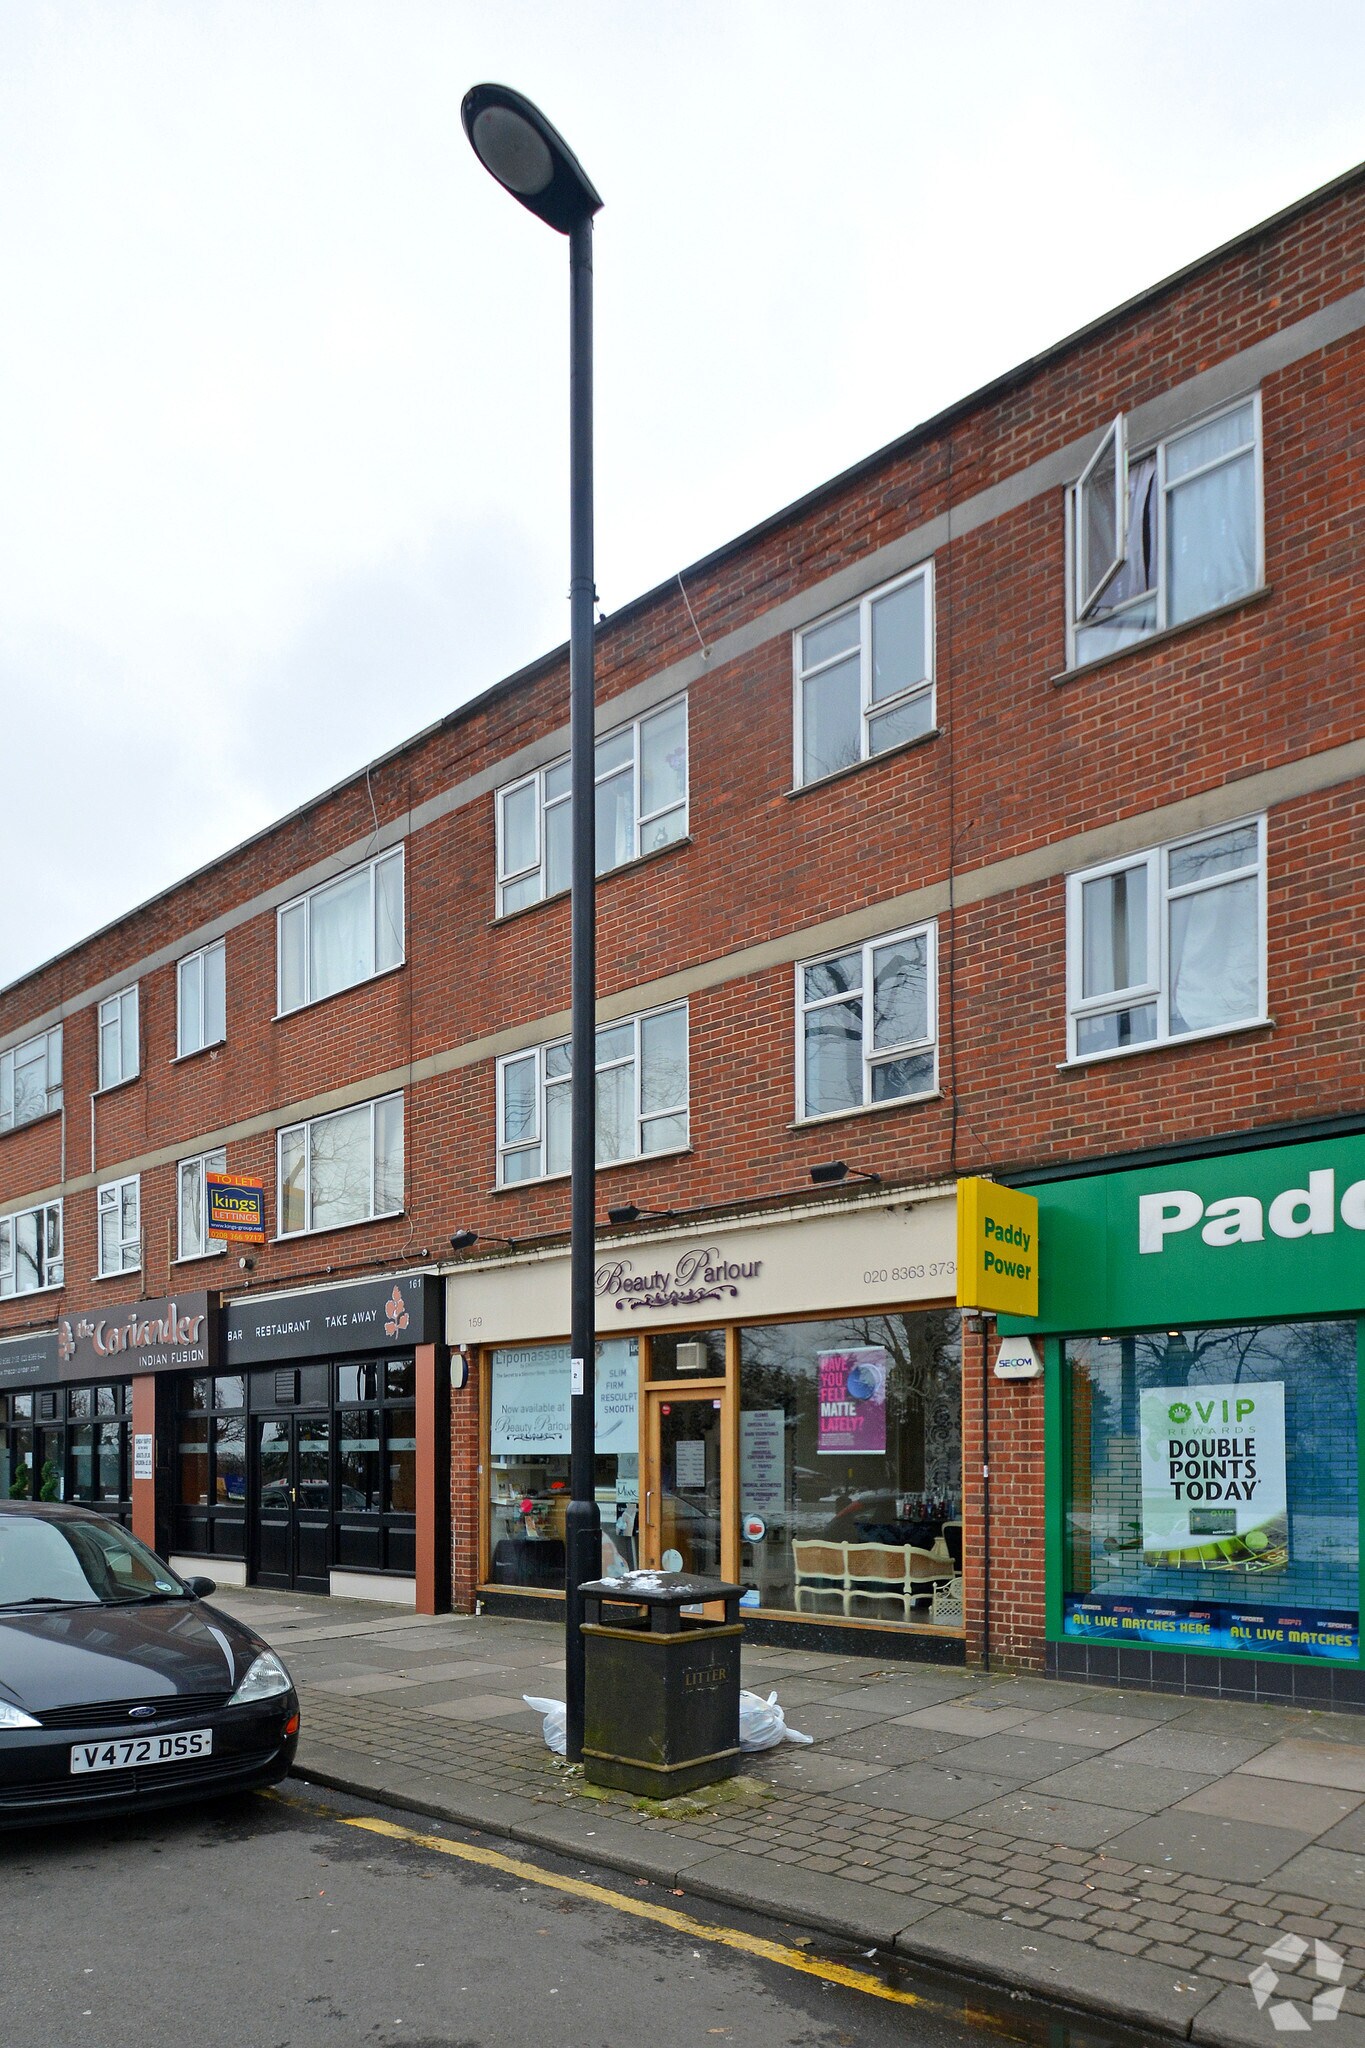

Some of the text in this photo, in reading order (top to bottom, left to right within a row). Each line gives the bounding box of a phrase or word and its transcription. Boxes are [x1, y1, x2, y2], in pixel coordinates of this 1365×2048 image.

[214, 1174, 254, 1187] TO LET
[215, 1193, 257, 1212] kings
[214, 1211, 258, 1222] LETTINGS
[210, 1223, 262, 1232] www.kings-group.net
[211, 1231, 228, 1239] 0208
[984, 1216, 1031, 1252] Paddy
[594, 1247, 763, 1297] Beauty Parlour
[863, 1261, 958, 1284] 020 8363 373
[984, 1250, 1031, 1280] Power
[408, 1278, 421, 1289] 161
[227, 1309, 378, 1341] BAR RESTAURANT TAKE AWAY
[468, 1316, 483, 1328] 159
[92, 1302, 205, 1358] Coriander
[139, 1349, 205, 1367] INDIAN FUSION
[821, 1356, 848, 1371] HAVE
[998, 1357, 1032, 1368] SECOM
[608, 1369, 627, 1378] SLIM
[821, 1372, 843, 1387] YOU
[605, 1381, 624, 1390] FIRM
[600, 1392, 638, 1402] RESCULPT
[821, 1387, 847, 1402] FELT
[501, 1403, 565, 1414] Now available at
[604, 1405, 635, 1414] SMOOTH
[821, 1402, 857, 1416] MATTE
[1195, 1398, 1255, 1424] VIP
[494, 1414, 571, 1434] Beauty Parlou
[821, 1416, 864, 1432] LATELY?
[1168, 1426, 1256, 1436] REWARDS
[1169, 1438, 1256, 1459] DOUBLE
[1170, 1460, 1257, 1479] POINTS
[1189, 1611, 1211, 1619] ESPN
[1240, 1615, 1264, 1623] SPORTS
[1278, 1618, 1302, 1626] ESPN
[1072, 1613, 1211, 1635] ALL LIVE MATCHES HERE
[1230, 1626, 1252, 1639] ALL
[1256, 1628, 1284, 1642] LIVE
[1288, 1630, 1353, 1647] MATCHES
[685, 1668, 726, 1686] LITTER
[84, 1734, 203, 1768] V472 DSS
